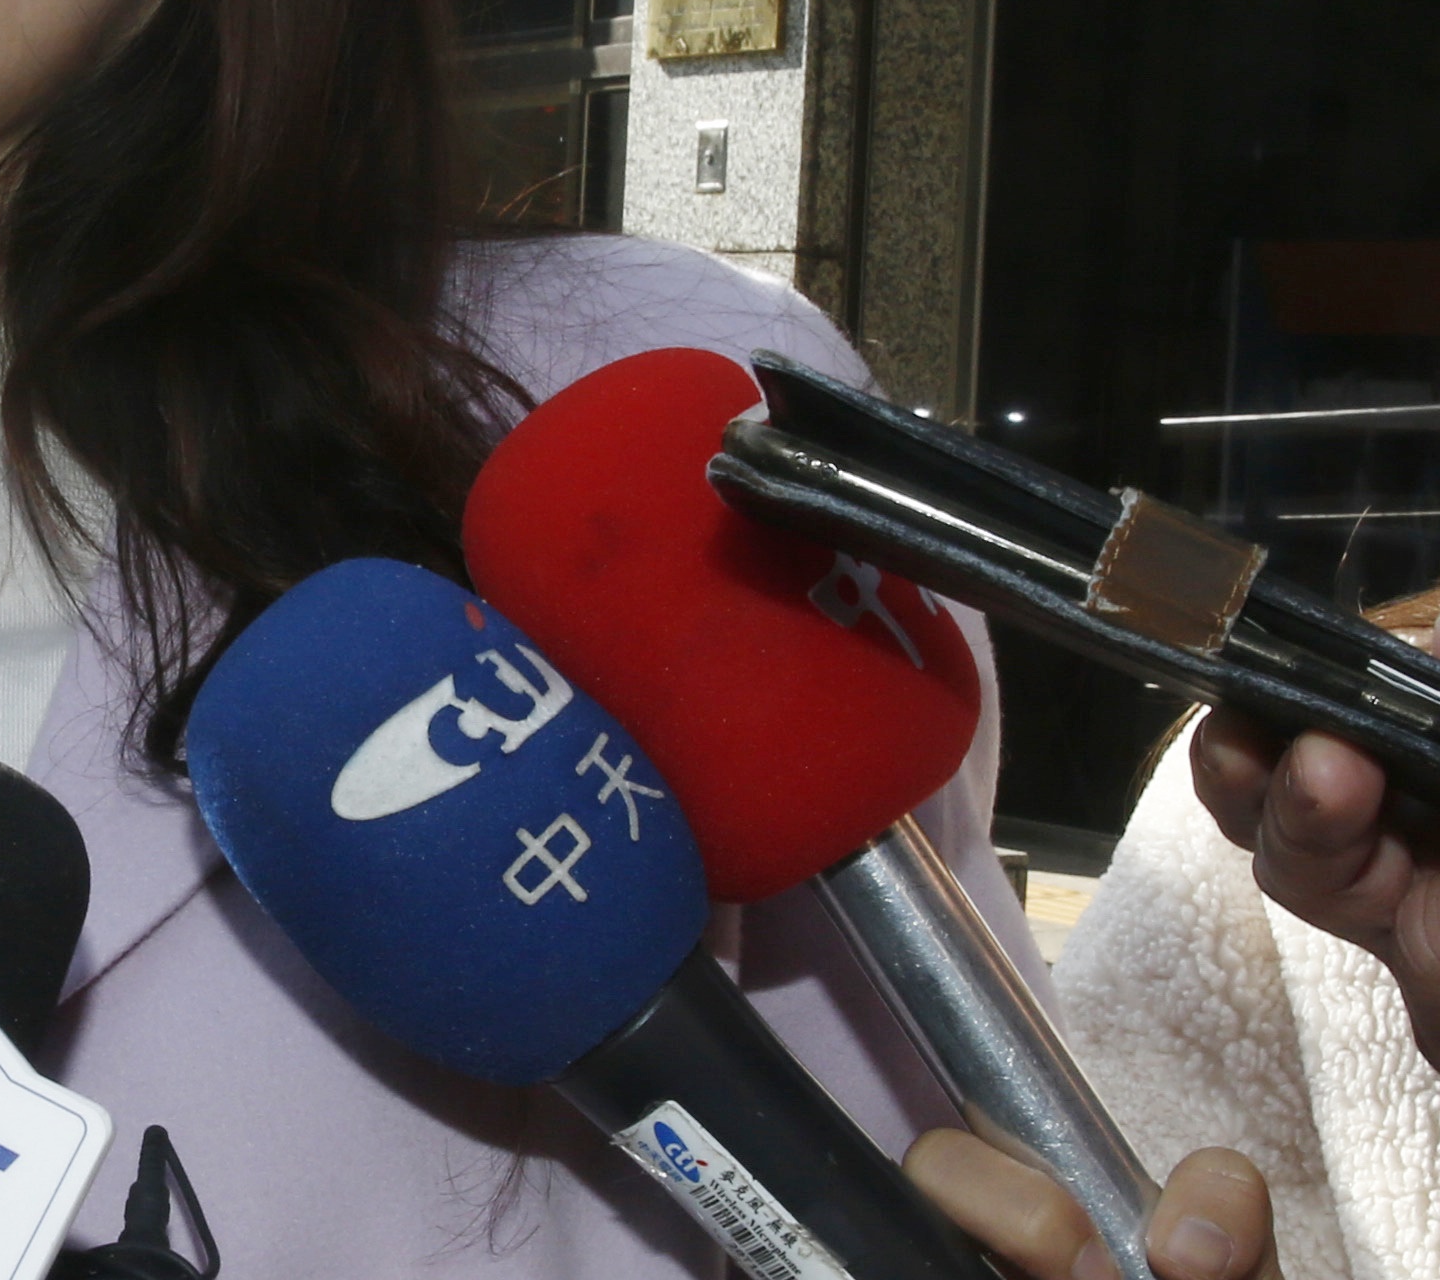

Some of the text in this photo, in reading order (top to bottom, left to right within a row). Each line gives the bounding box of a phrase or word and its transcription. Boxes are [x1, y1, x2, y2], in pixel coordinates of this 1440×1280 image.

[502, 733, 665, 905] 中天
[709, 1178, 802, 1275] Wireless Microphone
